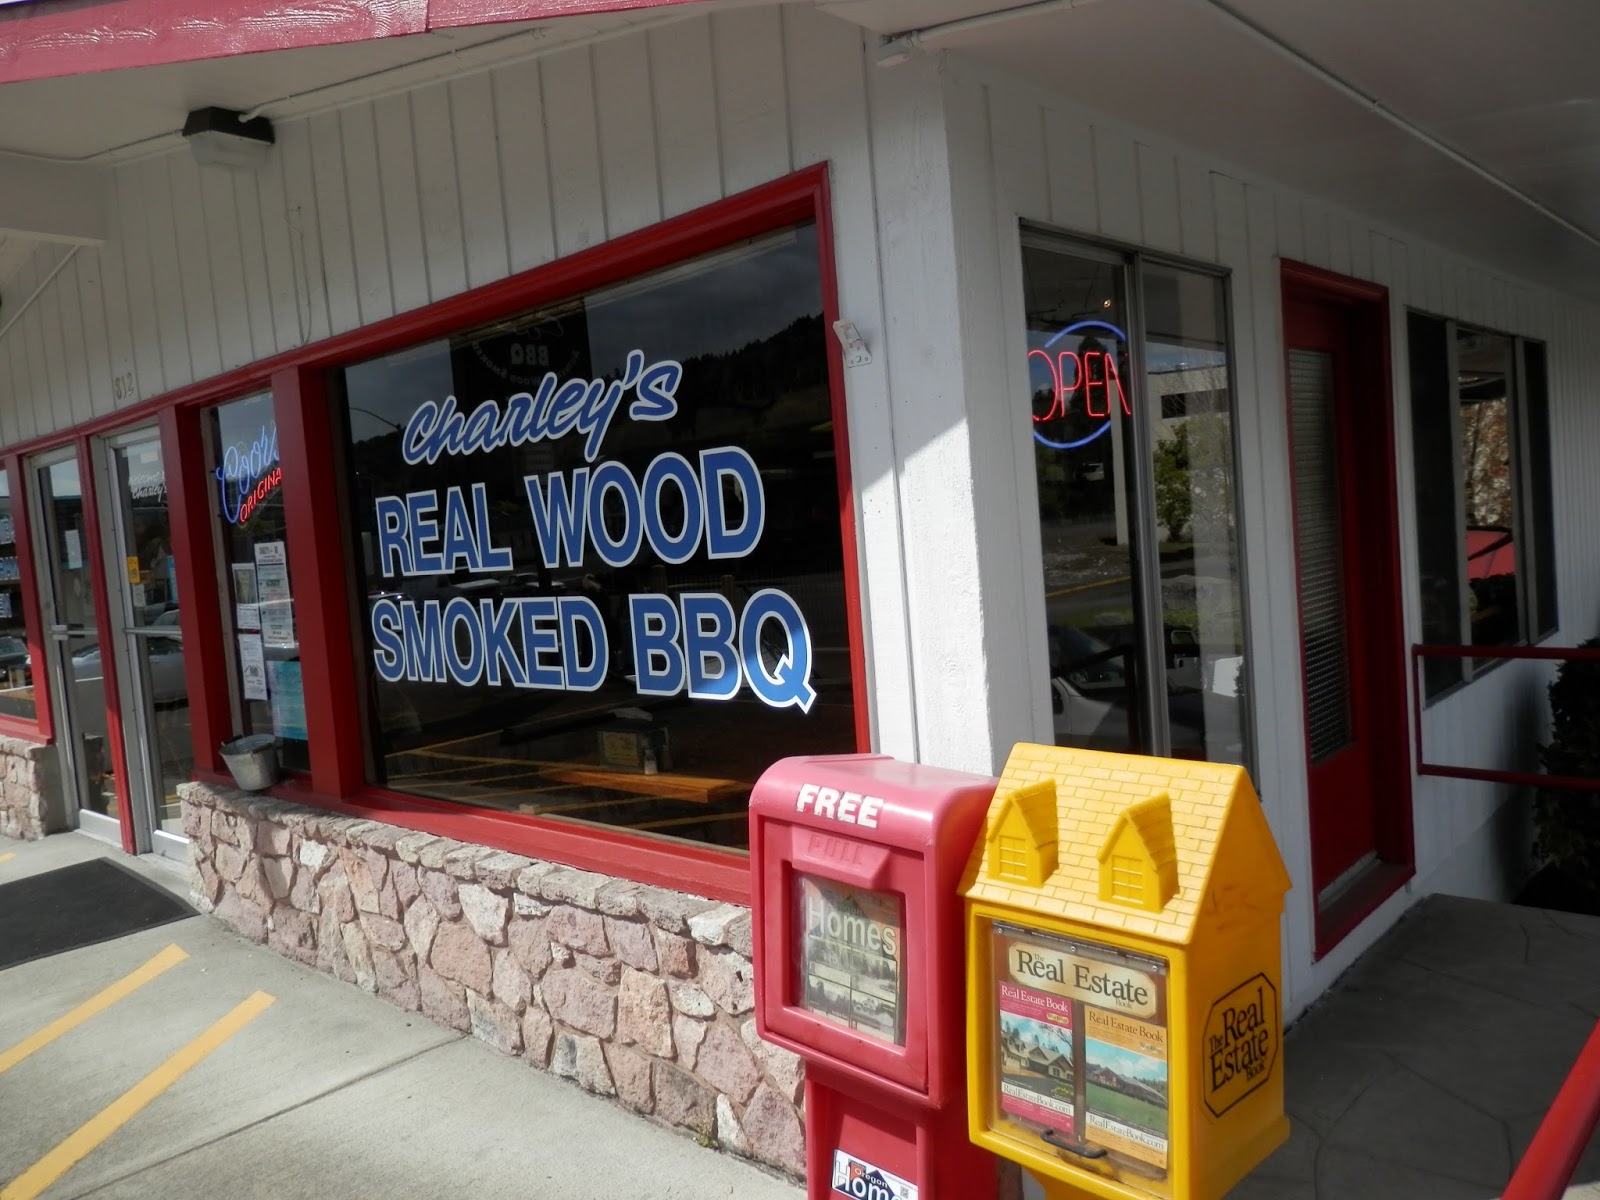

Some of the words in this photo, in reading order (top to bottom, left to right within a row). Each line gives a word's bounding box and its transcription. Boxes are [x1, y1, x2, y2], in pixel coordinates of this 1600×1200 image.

[402, 348, 684, 465] Charley's
[1027, 349, 1132, 422] OPEN
[239, 467, 282, 523] ORIGINA
[374, 482, 515, 579] REAL
[523, 445, 766, 570] WOOD
[371, 595, 610, 693] SMOKED
[628, 587, 818, 715] BBQ
[795, 783, 885, 829] FREE
[808, 896, 898, 956] Homes
[1001, 985, 1020, 1000] Real
[1021, 990, 1046, 1007] Estate
[1046, 996, 1069, 1014] Book
[1016, 949, 1066, 985] Real
[1073, 964, 1148, 1006] Estate
[1088, 1010, 1110, 1026] Real
[1110, 1016, 1139, 1035] Estate
[1139, 1025, 1164, 1044] Book
[1115, 998, 1133, 1010] Book
[1222, 986, 1266, 1048] Real
[1208, 1033, 1224, 1055] The
[1209, 1028, 1269, 1094] Estate
[1245, 1058, 1266, 1082] Book
[1003, 1083, 1072, 1115] RealEstateBook.com
[1089, 1114, 1165, 1150] RealEstateBook.com
[833, 1160, 904, 1200] Hom
[854, 1168, 890, 1189] Oregon
